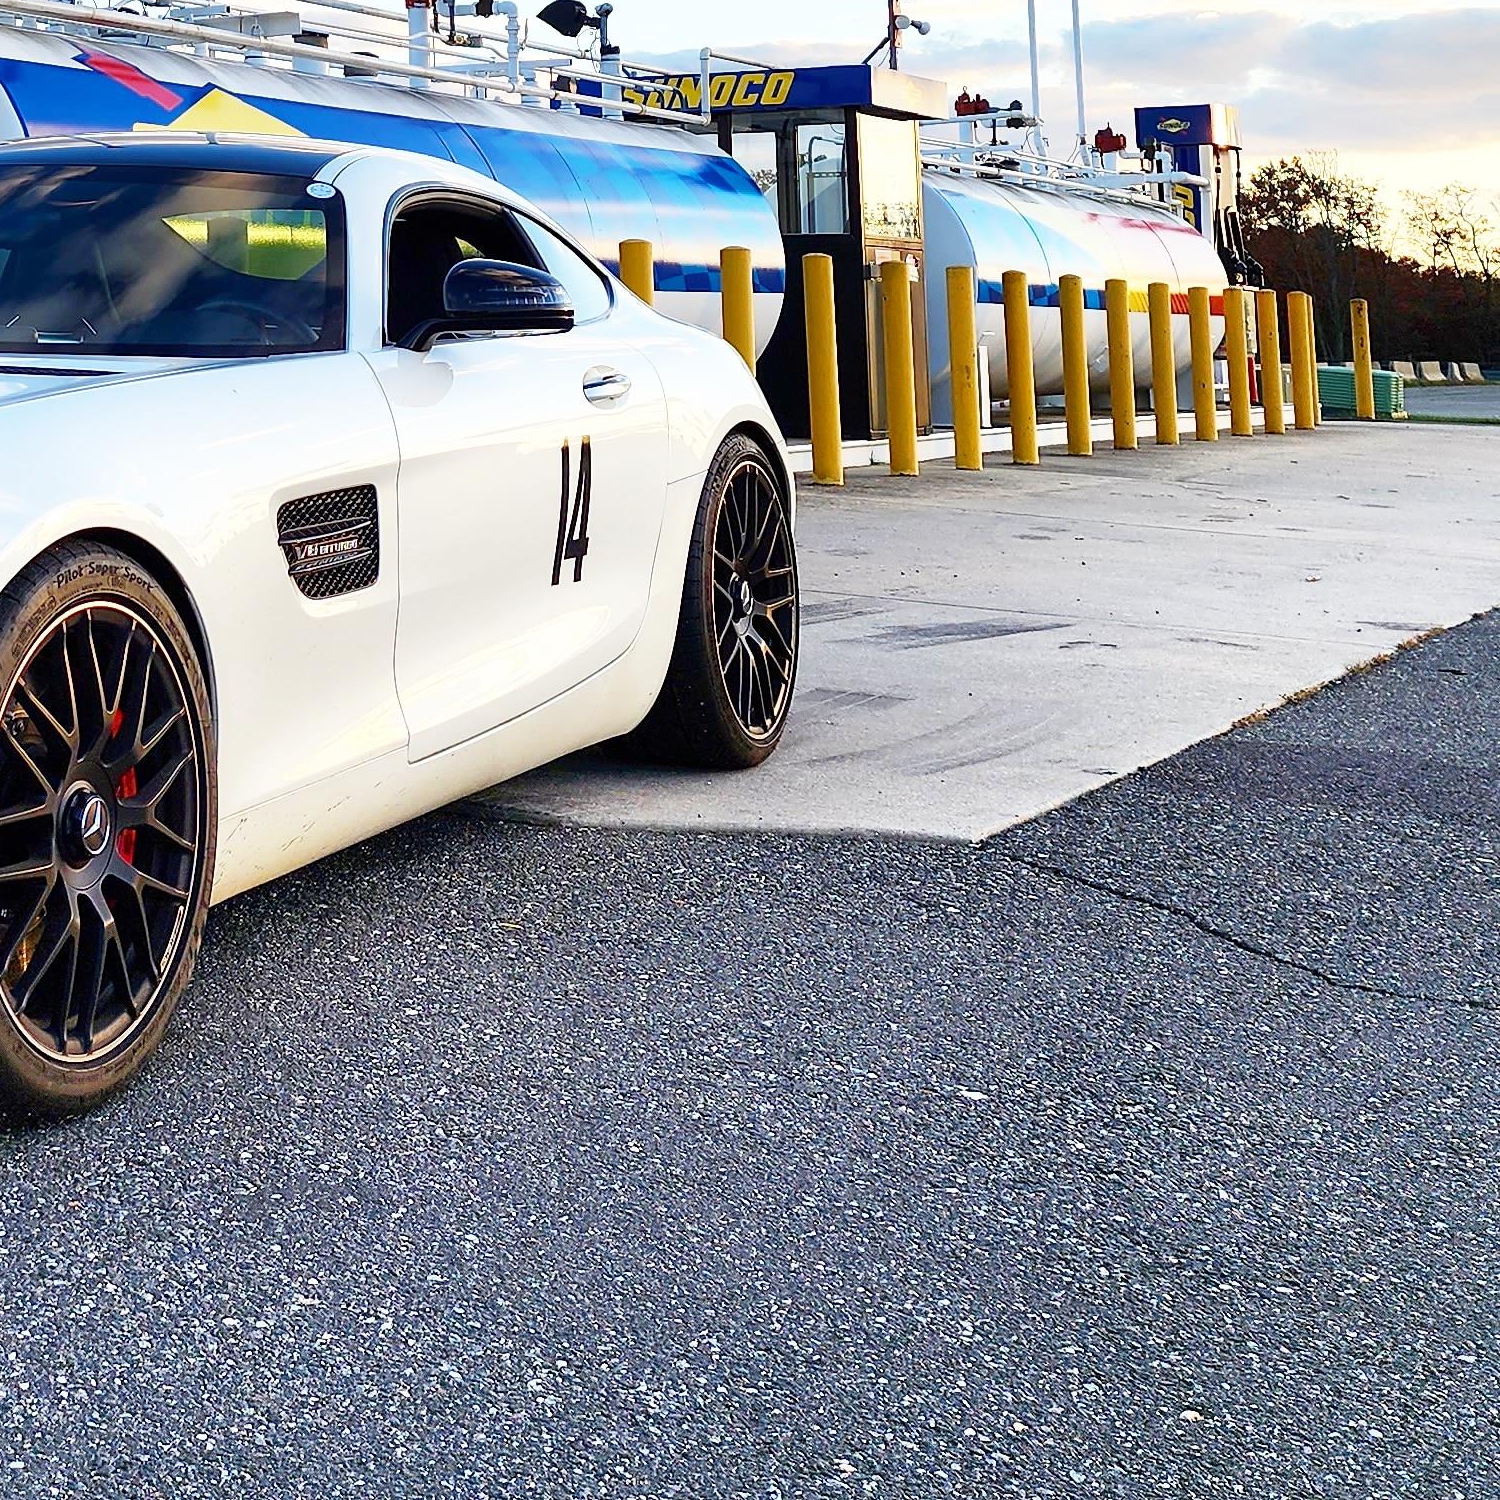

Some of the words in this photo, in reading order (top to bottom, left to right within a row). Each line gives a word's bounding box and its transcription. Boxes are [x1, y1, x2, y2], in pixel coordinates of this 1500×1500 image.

[551, 436, 592, 586] 14
[56, 565, 84, 588] Pilot
[88, 561, 121, 577] Super
[124, 567, 154, 592] Sport
